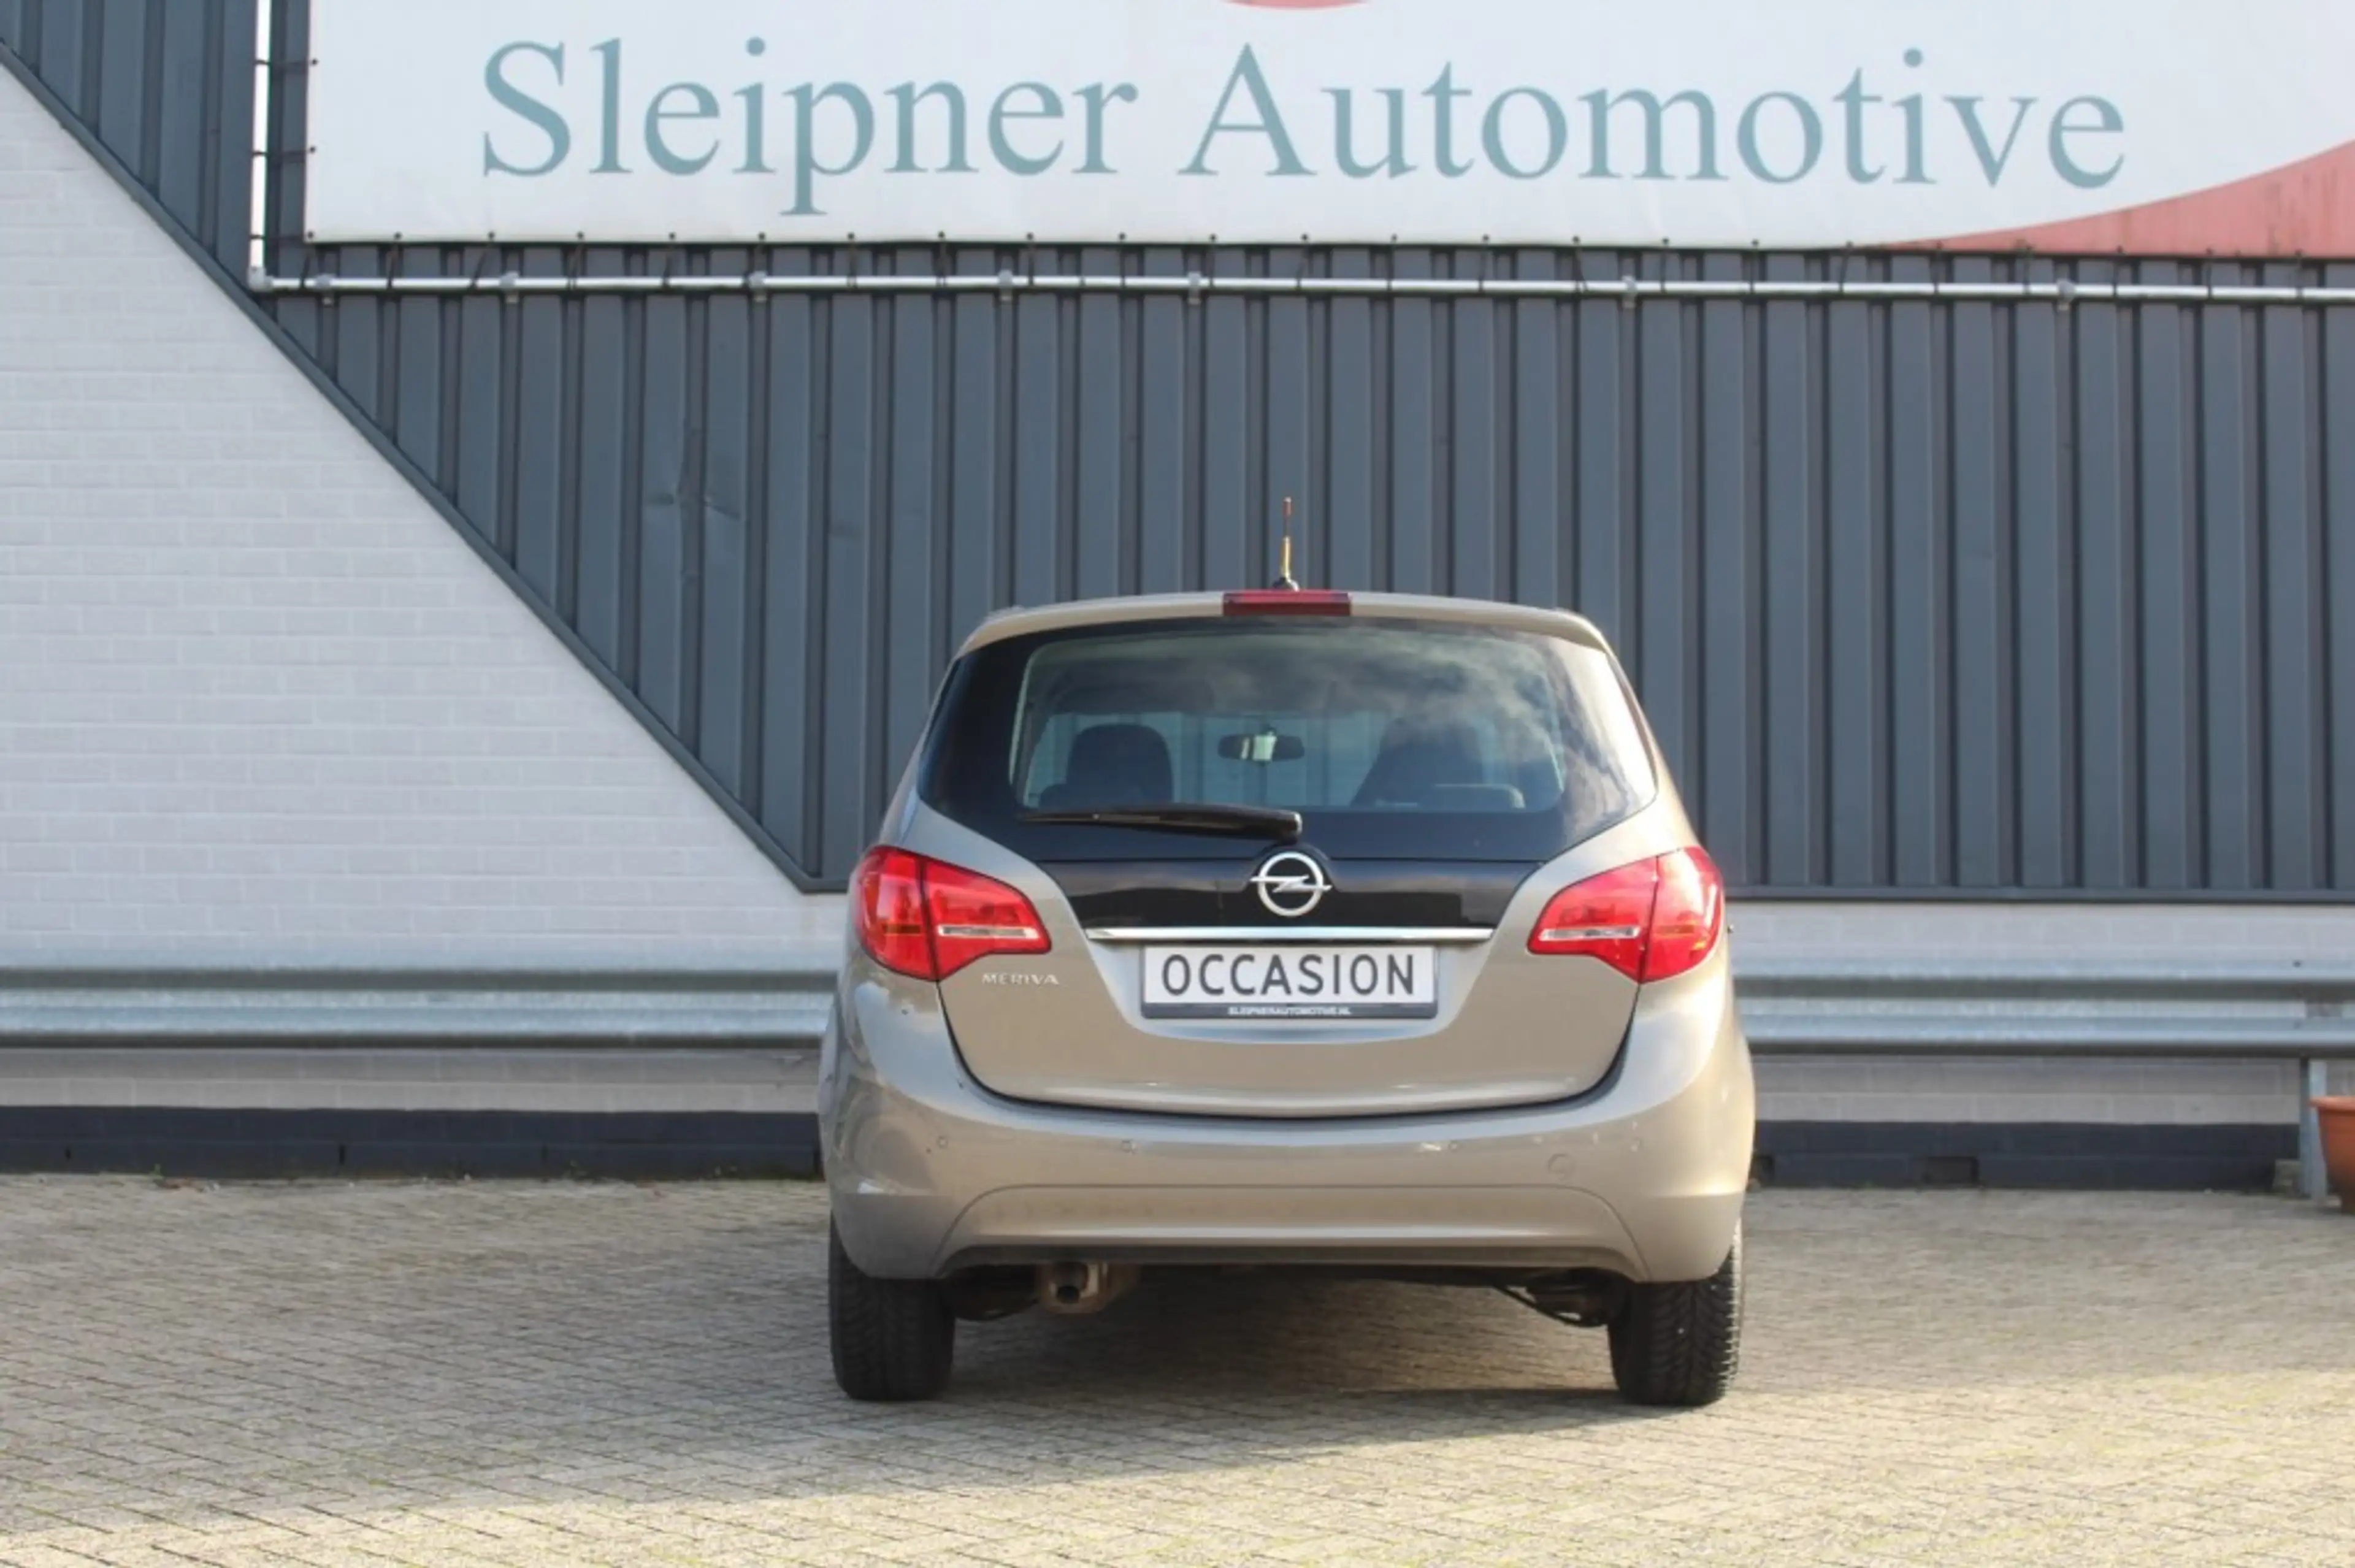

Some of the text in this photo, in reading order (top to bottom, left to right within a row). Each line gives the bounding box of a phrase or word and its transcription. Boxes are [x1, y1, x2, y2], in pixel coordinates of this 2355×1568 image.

[483, 37, 2123, 216] Sleipner Automotive
[982, 973, 1060, 985] MERIVA
[1161, 954, 1414, 996] OCCASION
